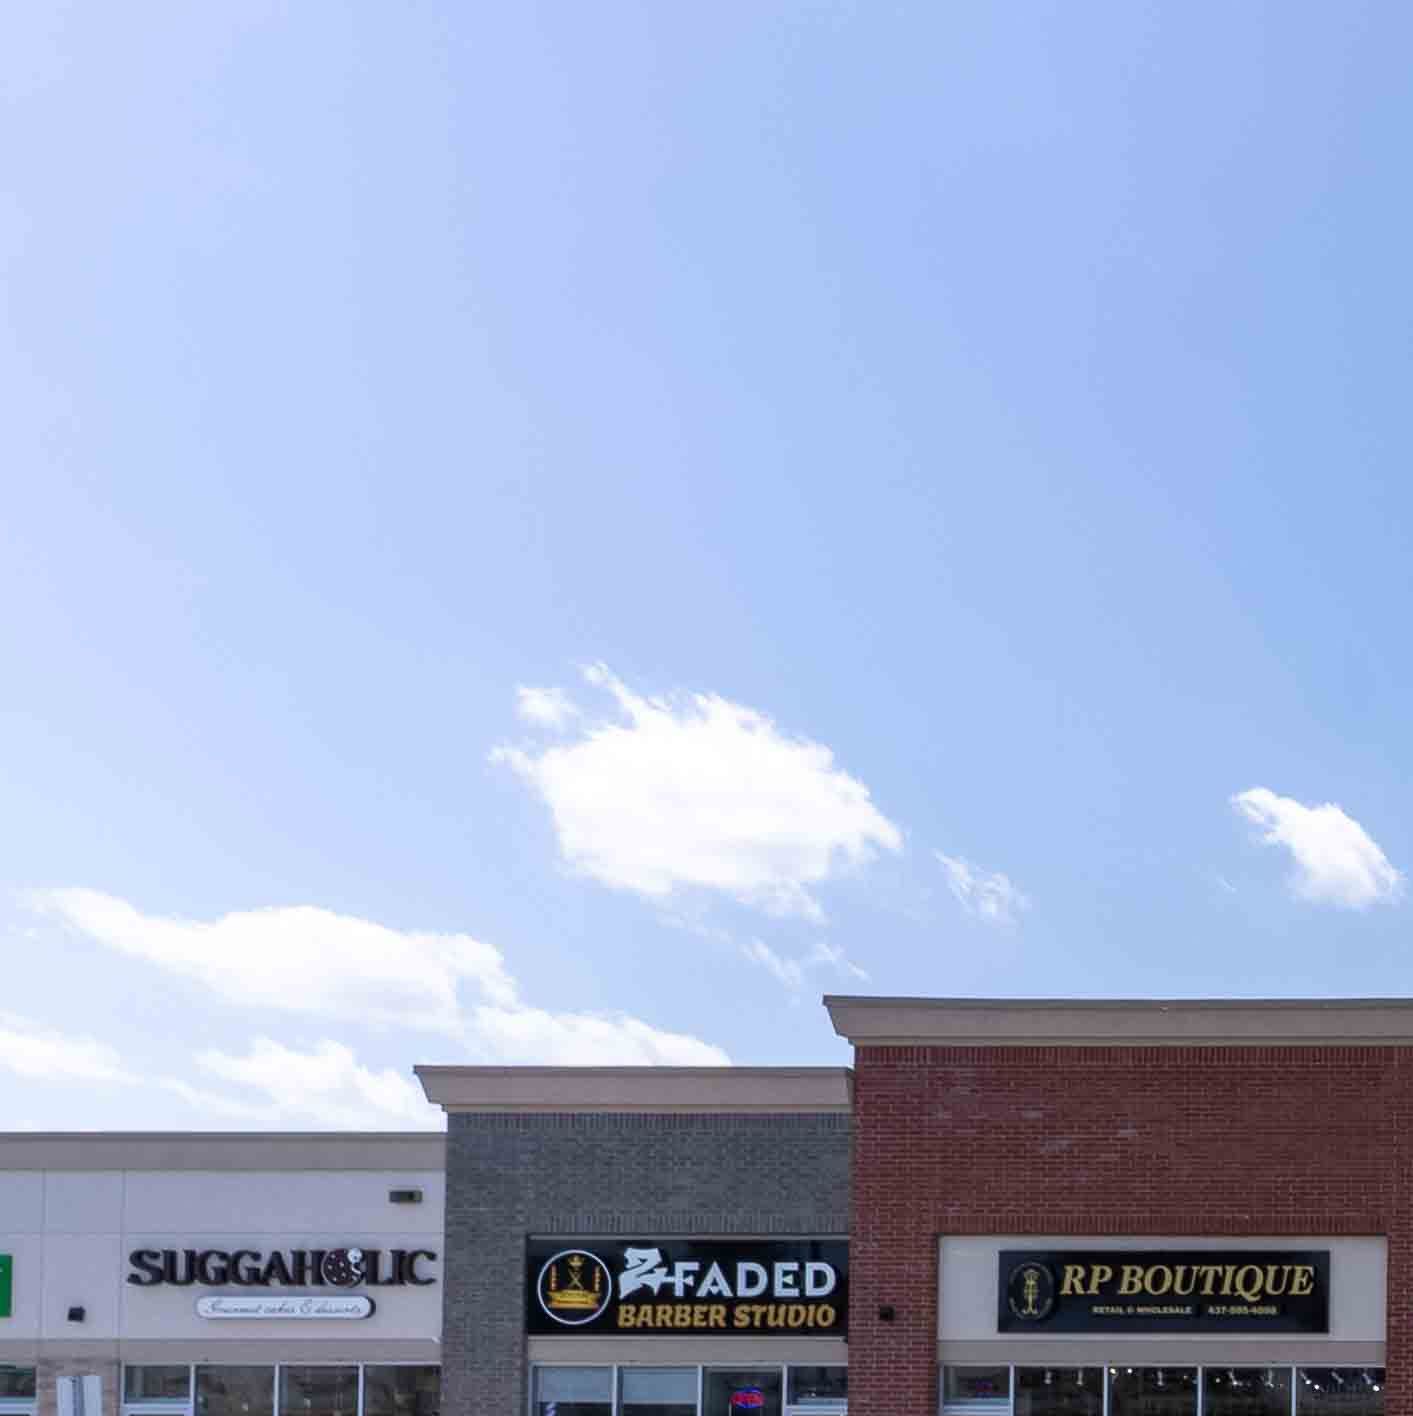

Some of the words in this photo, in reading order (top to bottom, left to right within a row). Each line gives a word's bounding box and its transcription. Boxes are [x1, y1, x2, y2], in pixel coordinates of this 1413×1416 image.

[127, 1248, 437, 1287] SUGGAHOLIC
[1060, 1265, 1112, 1296] RP
[1118, 1265, 1315, 1301] BOUTIQUE
[618, 1304, 727, 1327] BARBER
[734, 1304, 836, 1327] STUDIO
[1092, 1306, 1124, 1315] RETAIL
[1137, 1306, 1193, 1315] WHOLESALE
